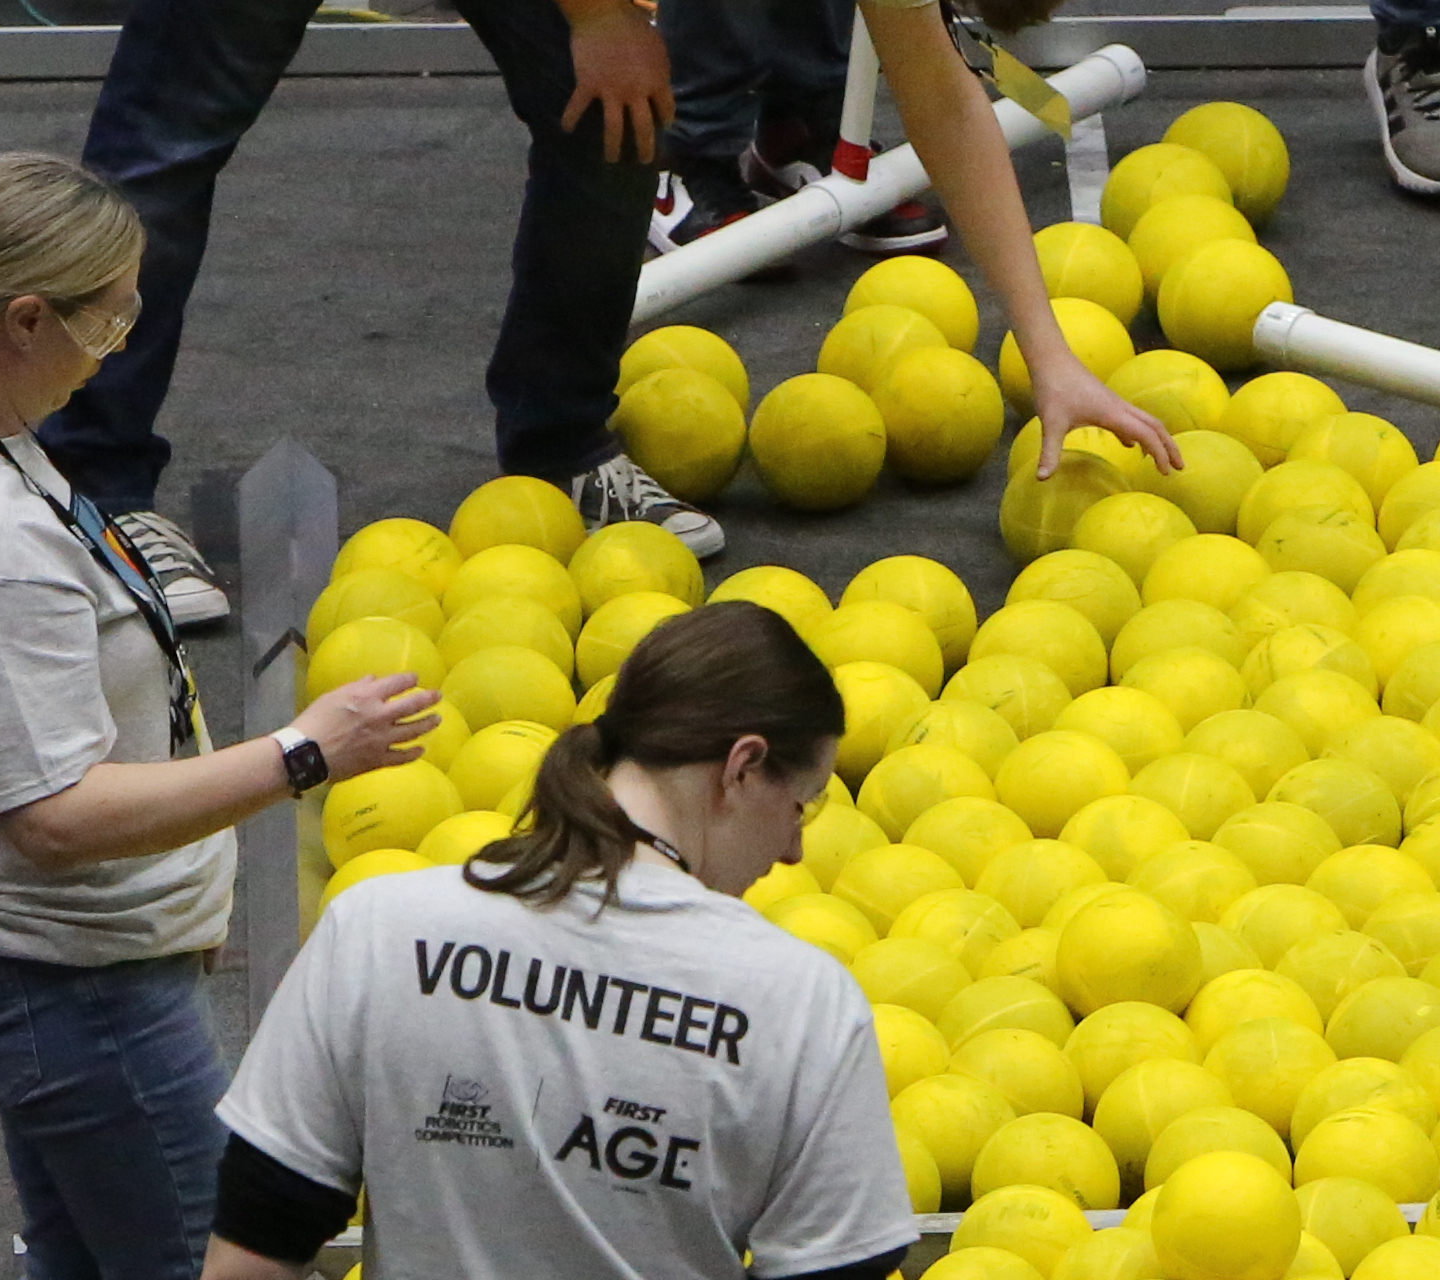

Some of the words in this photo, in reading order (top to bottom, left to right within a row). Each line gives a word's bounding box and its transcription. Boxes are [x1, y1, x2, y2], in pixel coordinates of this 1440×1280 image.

[415, 939, 750, 1066] VOLUNTEER
[439, 1101, 491, 1118] FIRST
[602, 1098, 666, 1124] FIRST
[425, 1115, 501, 1134] ROBOTICS
[415, 1129, 514, 1148] COMPETITION
[555, 1115, 700, 1190] AGE
